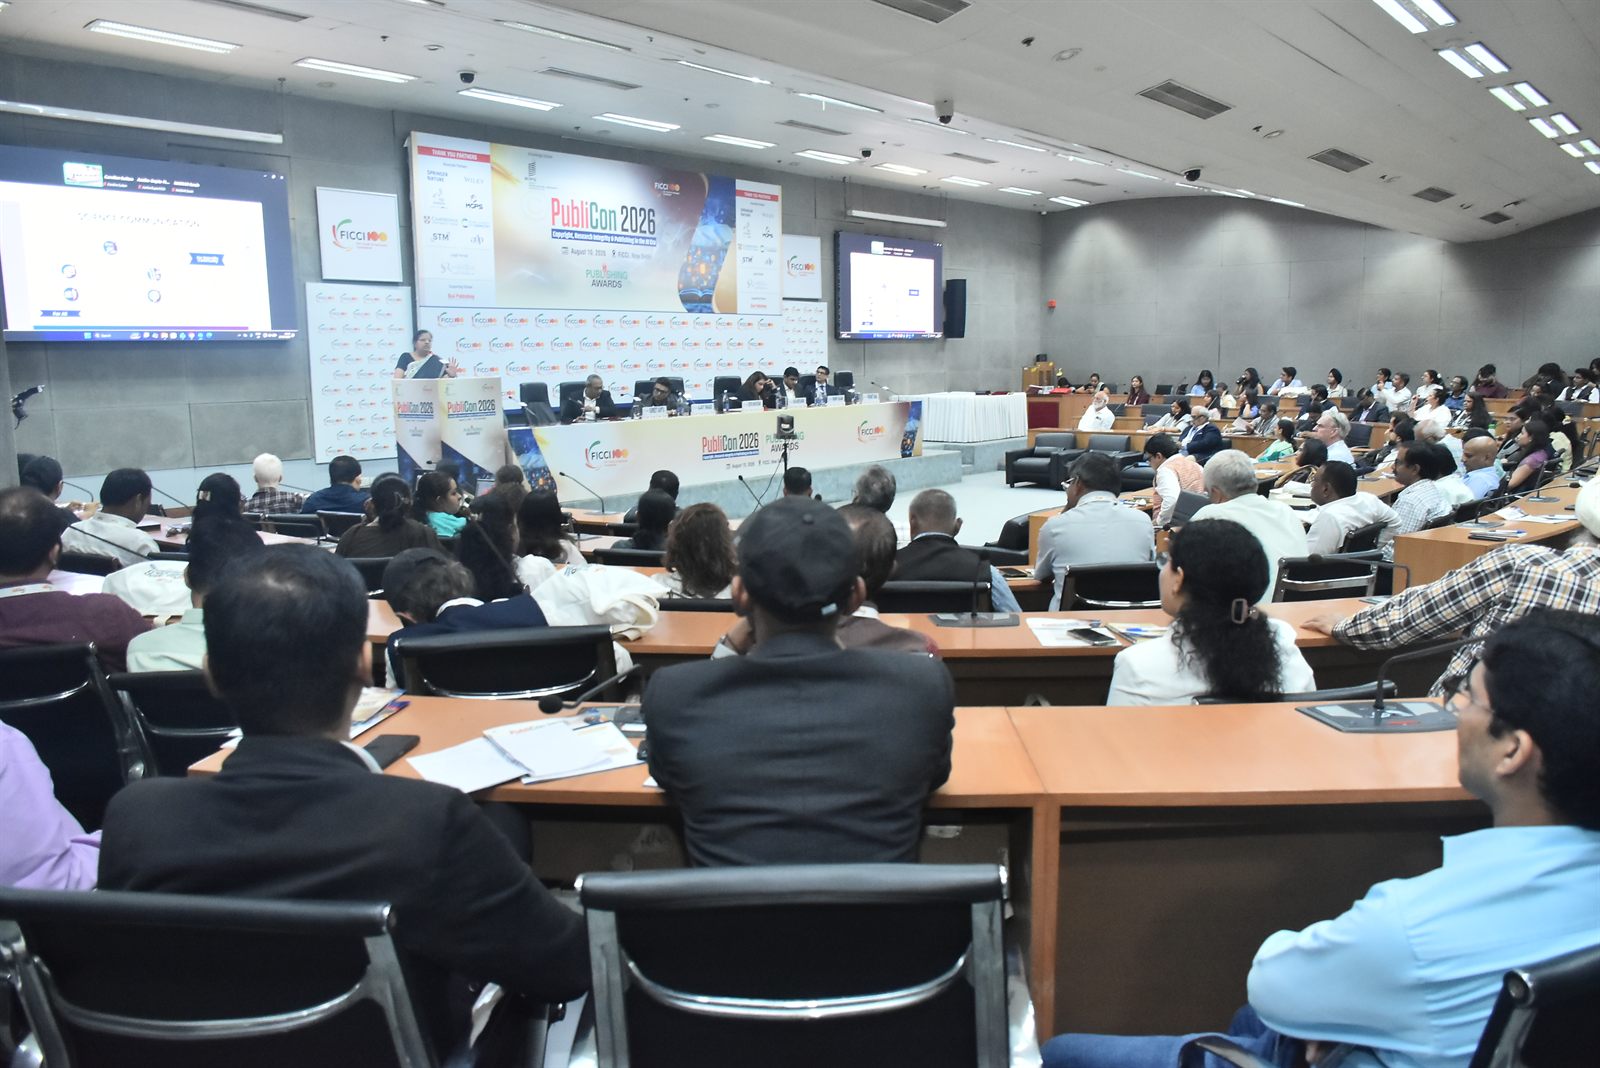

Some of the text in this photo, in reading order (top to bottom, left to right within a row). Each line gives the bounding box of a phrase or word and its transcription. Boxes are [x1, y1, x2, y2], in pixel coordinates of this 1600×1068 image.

[551, 197, 656, 235] PubliCon 2026
[340, 230, 365, 241] FICCI
[432, 232, 449, 241] STM
[591, 279, 622, 289] AWARDS
[397, 401, 434, 414] PubliCon 2026
[447, 399, 496, 413] PubliCon 2026
[702, 434, 738, 453] PubliCon
[739, 432, 759, 450] 2026
[591, 450, 611, 460] FICCI
